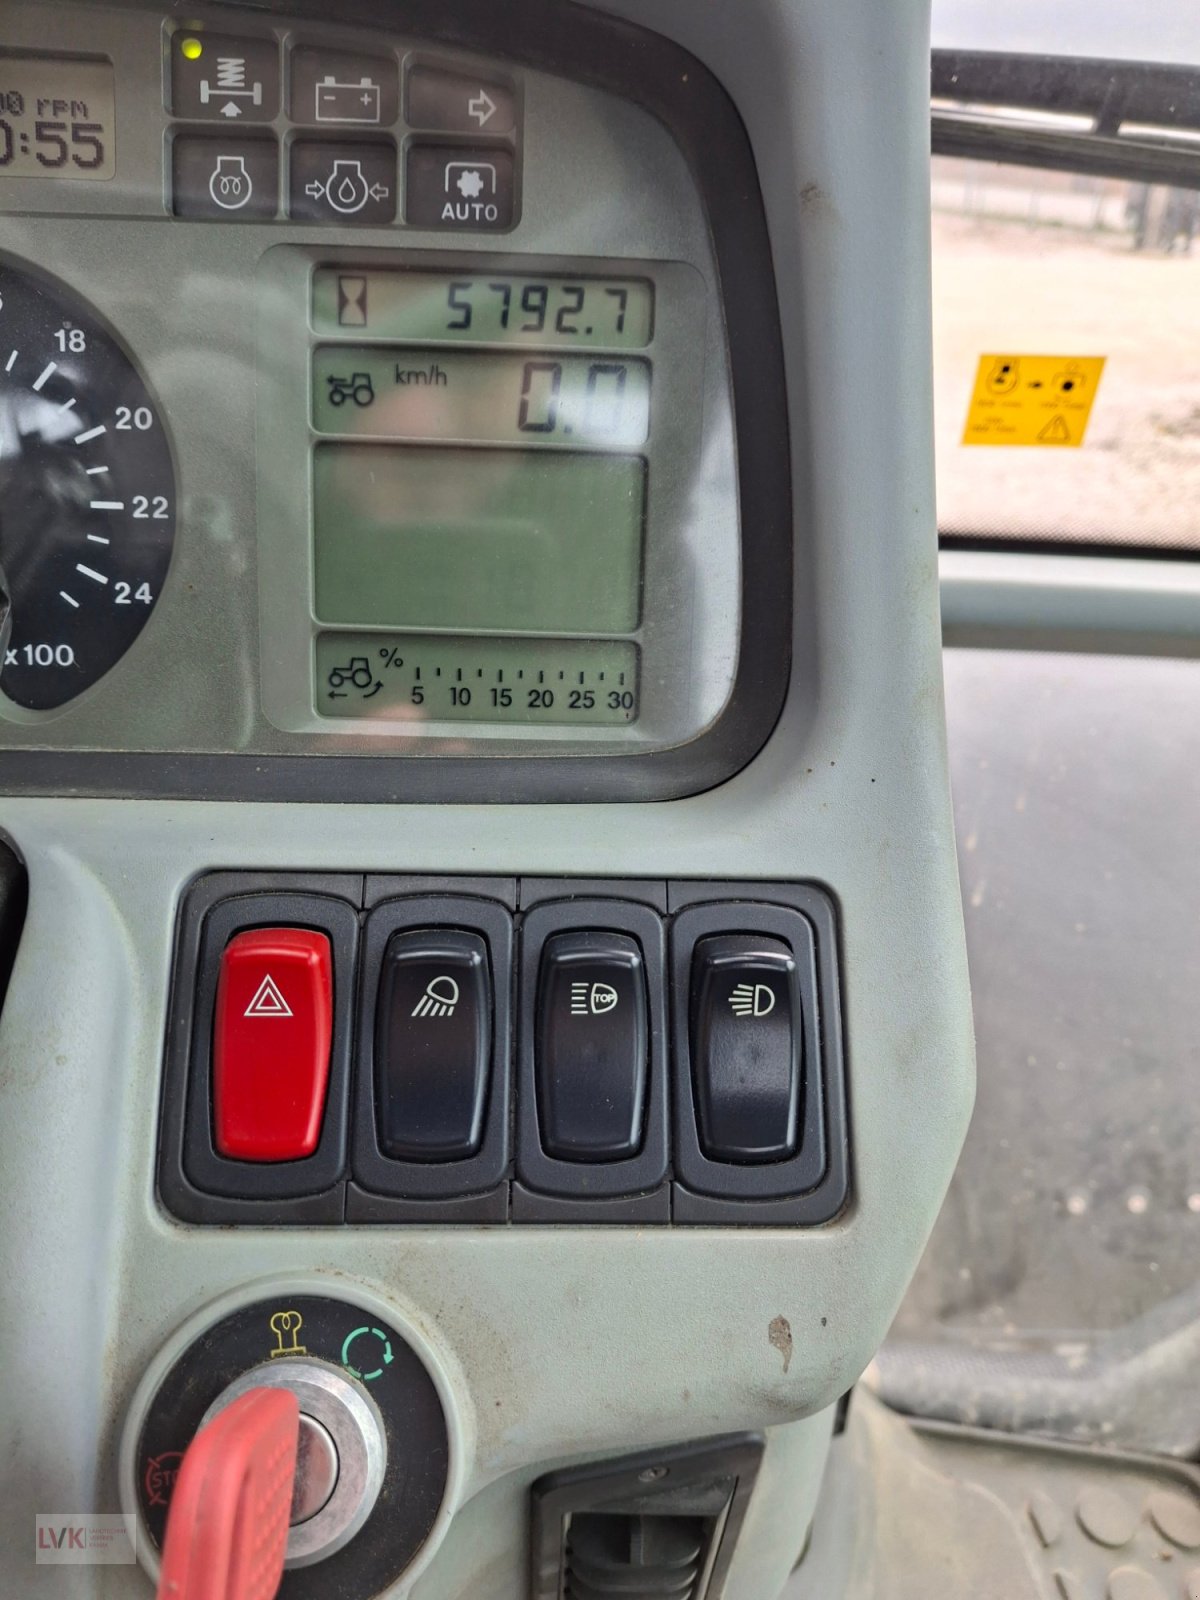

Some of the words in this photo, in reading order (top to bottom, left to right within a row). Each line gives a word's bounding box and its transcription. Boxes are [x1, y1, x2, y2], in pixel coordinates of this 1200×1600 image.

[0, 90, 24, 117] 0
[441, 203, 498, 222] AUTO
[447, 282, 628, 335] 5792.7
[54, 329, 86, 353] 18
[395, 364, 448, 386] km/h
[518, 362, 628, 434] 0.0
[115, 406, 153, 430] 20
[132, 496, 169, 519] 22
[115, 582, 153, 604] 24
[411, 686, 424, 704] 5
[450, 687, 471, 706] 10
[490, 688, 513, 707] 15
[528, 689, 554, 709] 20
[569, 690, 595, 709] 25
[608, 691, 634, 710] 30
[593, 993, 615, 1003] TOP
